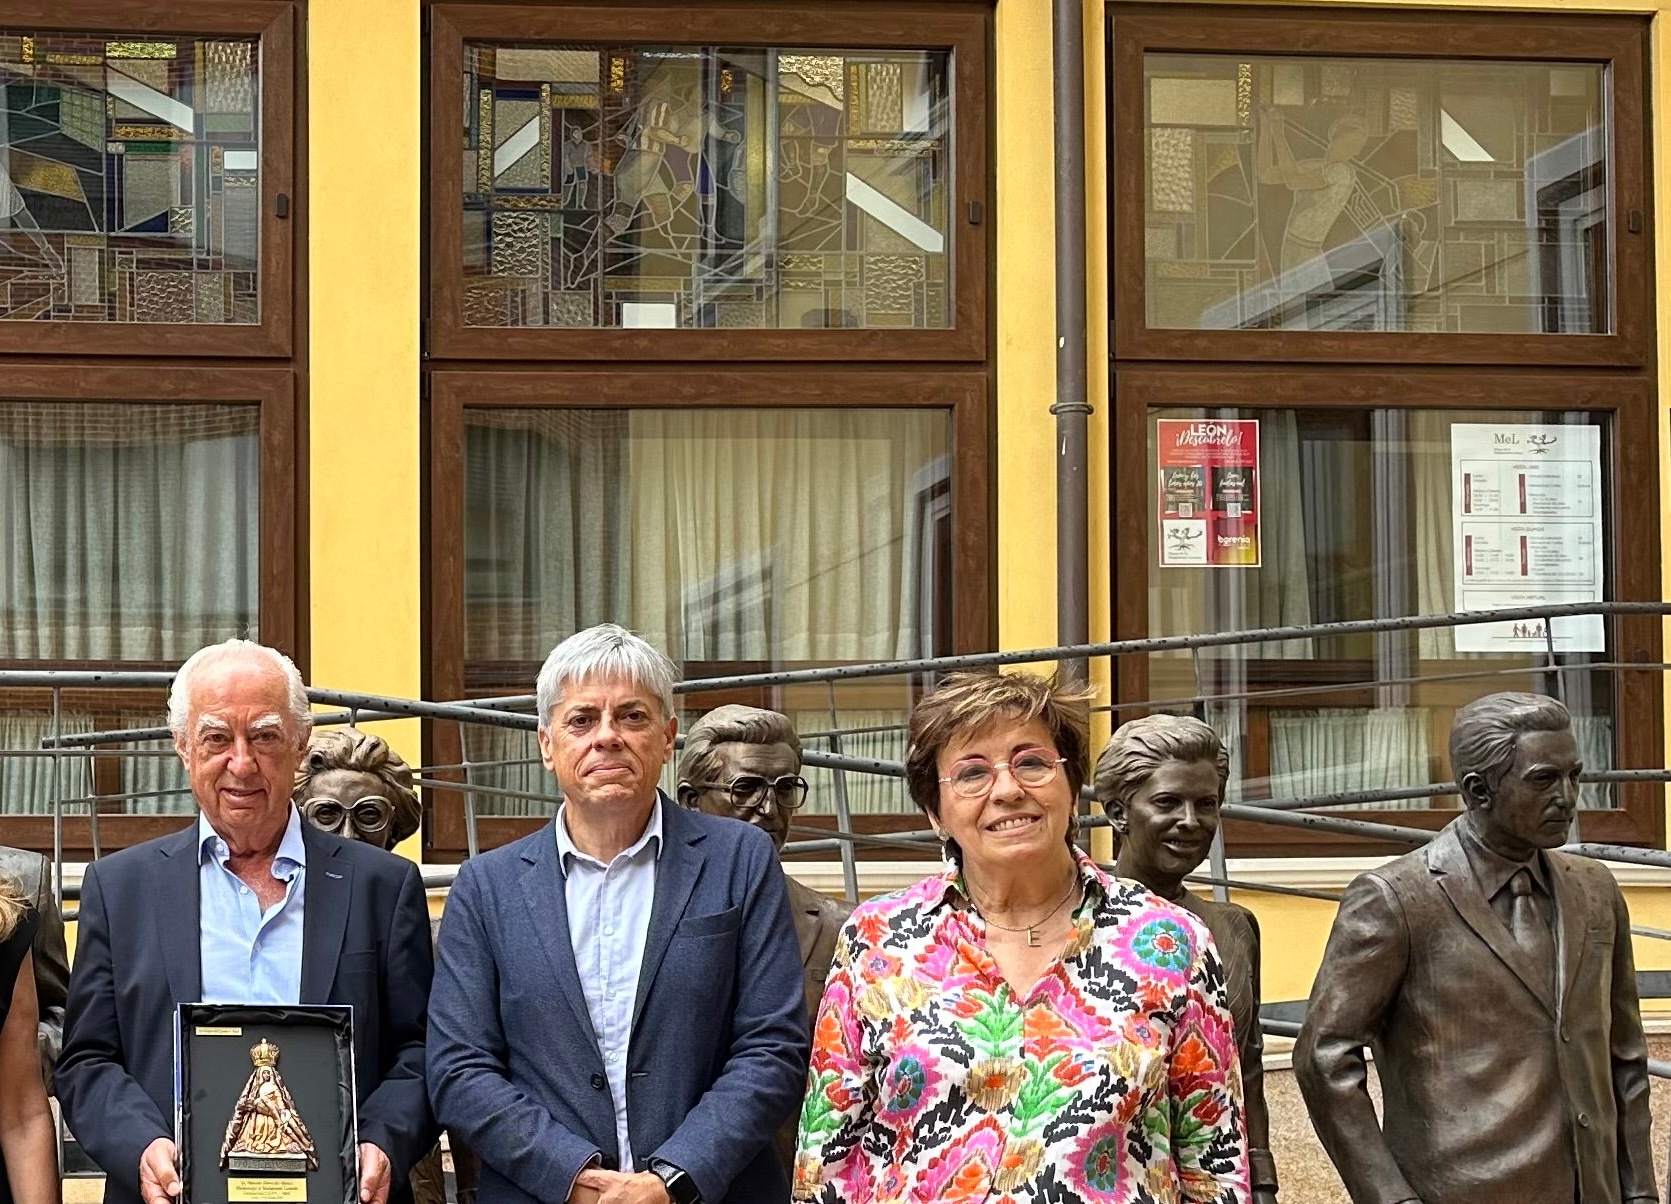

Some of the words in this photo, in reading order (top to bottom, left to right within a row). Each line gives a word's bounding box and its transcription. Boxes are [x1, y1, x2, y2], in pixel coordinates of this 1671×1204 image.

[1190, 421, 1227, 436] LEÓN
[1494, 433, 1520, 444] MeL
[1027, 930, 1041, 947] E
